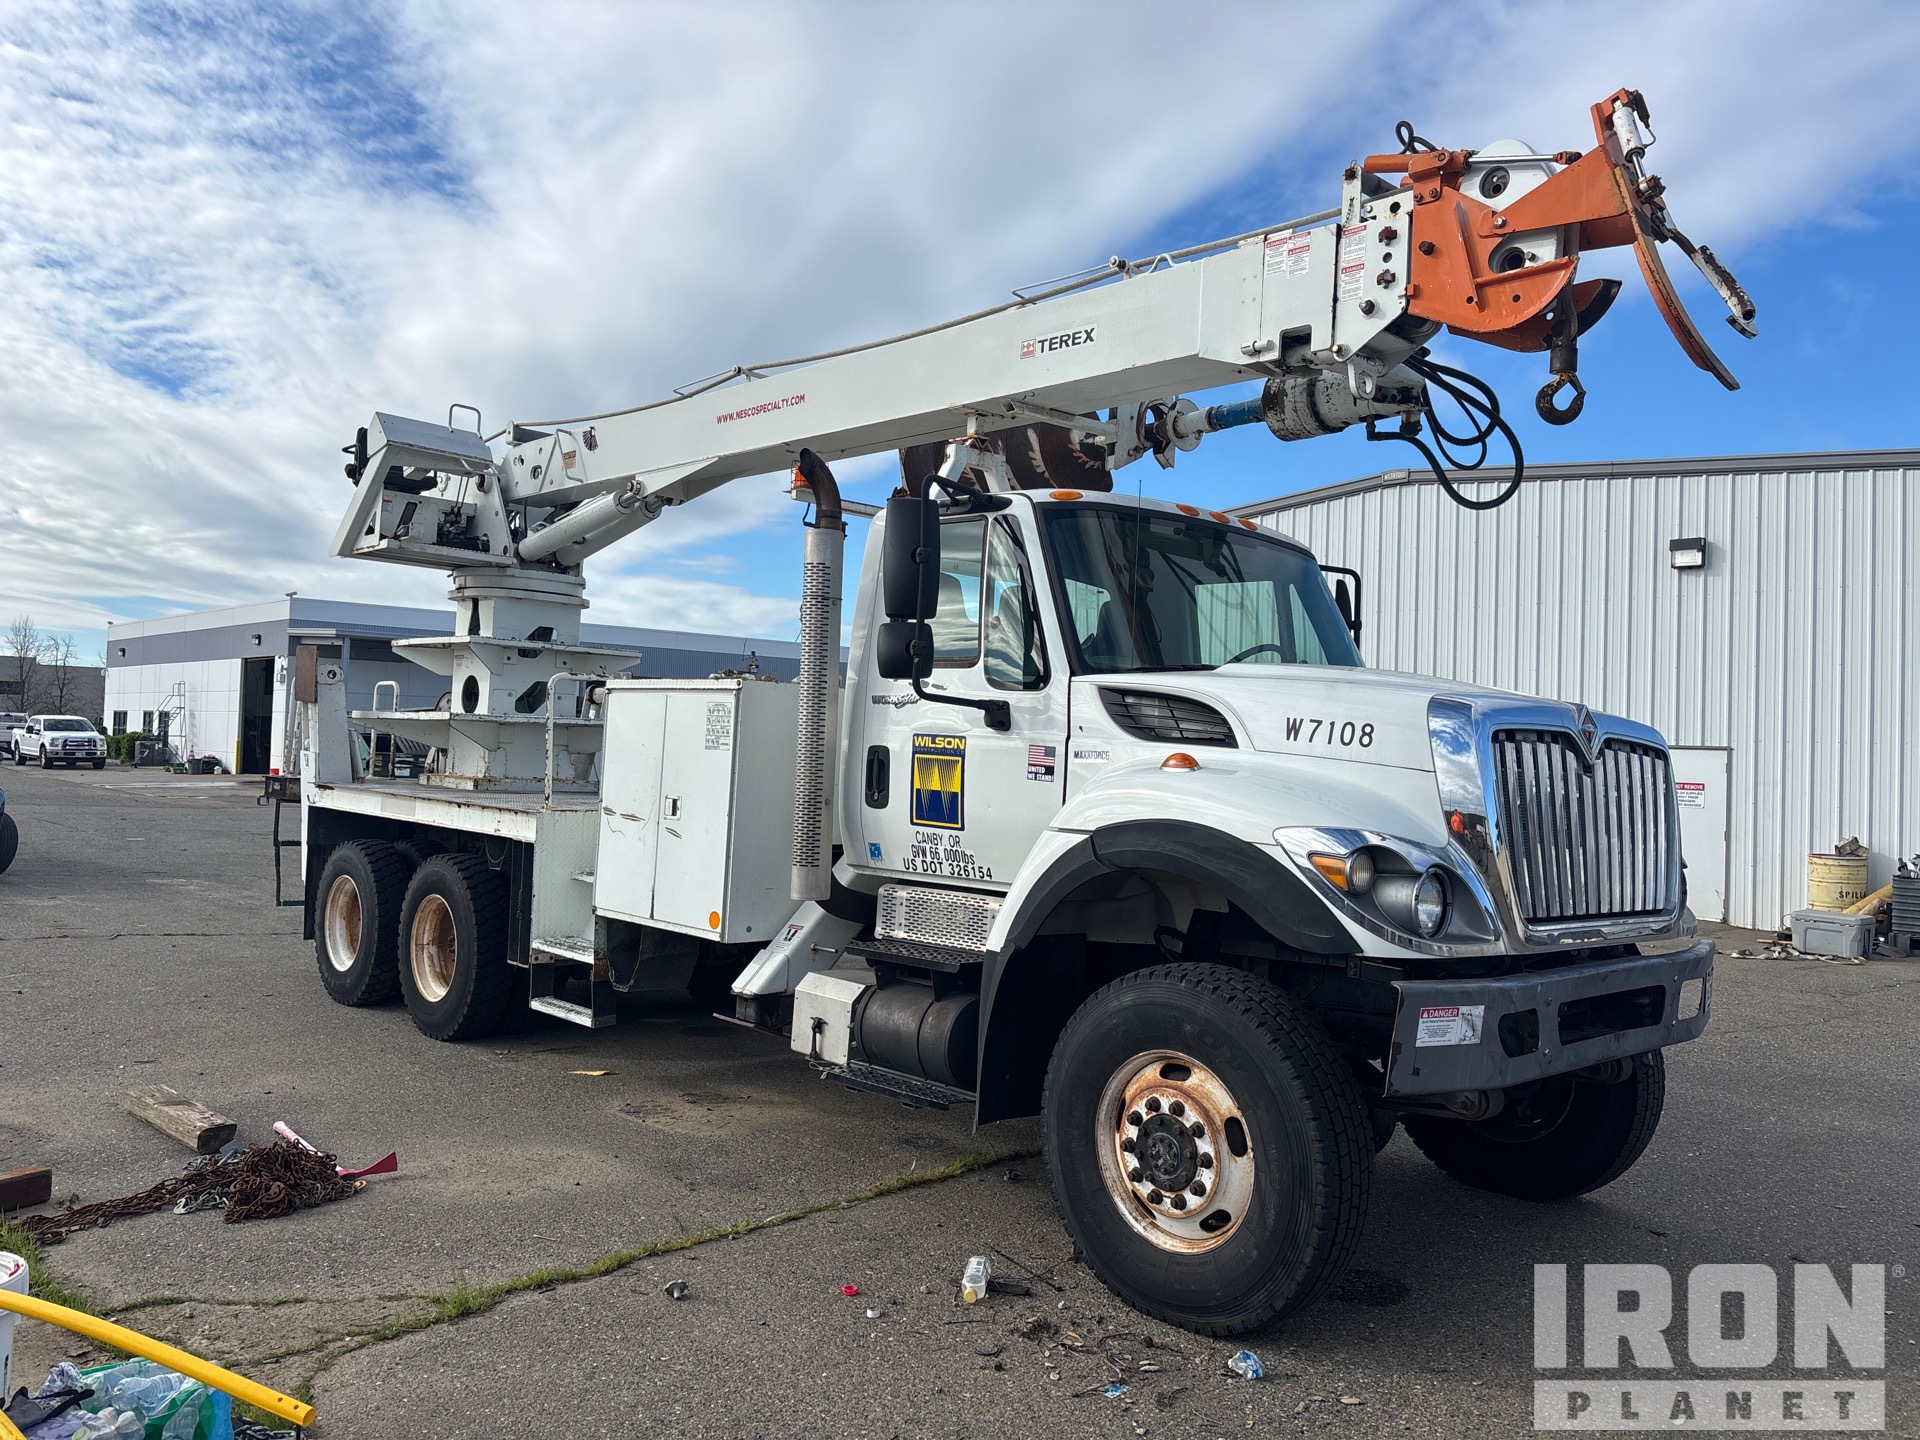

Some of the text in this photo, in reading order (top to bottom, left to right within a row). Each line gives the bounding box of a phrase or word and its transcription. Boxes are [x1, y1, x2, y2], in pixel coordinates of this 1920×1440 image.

[1038, 328, 1095, 353] TEREX
[716, 394, 806, 425] WWW.NESCOSPECIALTY.COM
[1286, 717, 1375, 748] W7108
[914, 736, 965, 750] WILSON
[1028, 766, 1046, 774] UNITED
[949, 835, 961, 848] OR
[911, 844, 927, 860] GVW
[903, 857, 993, 880] US DOT 326154
[1429, 1009, 1458, 1018] DANGER
